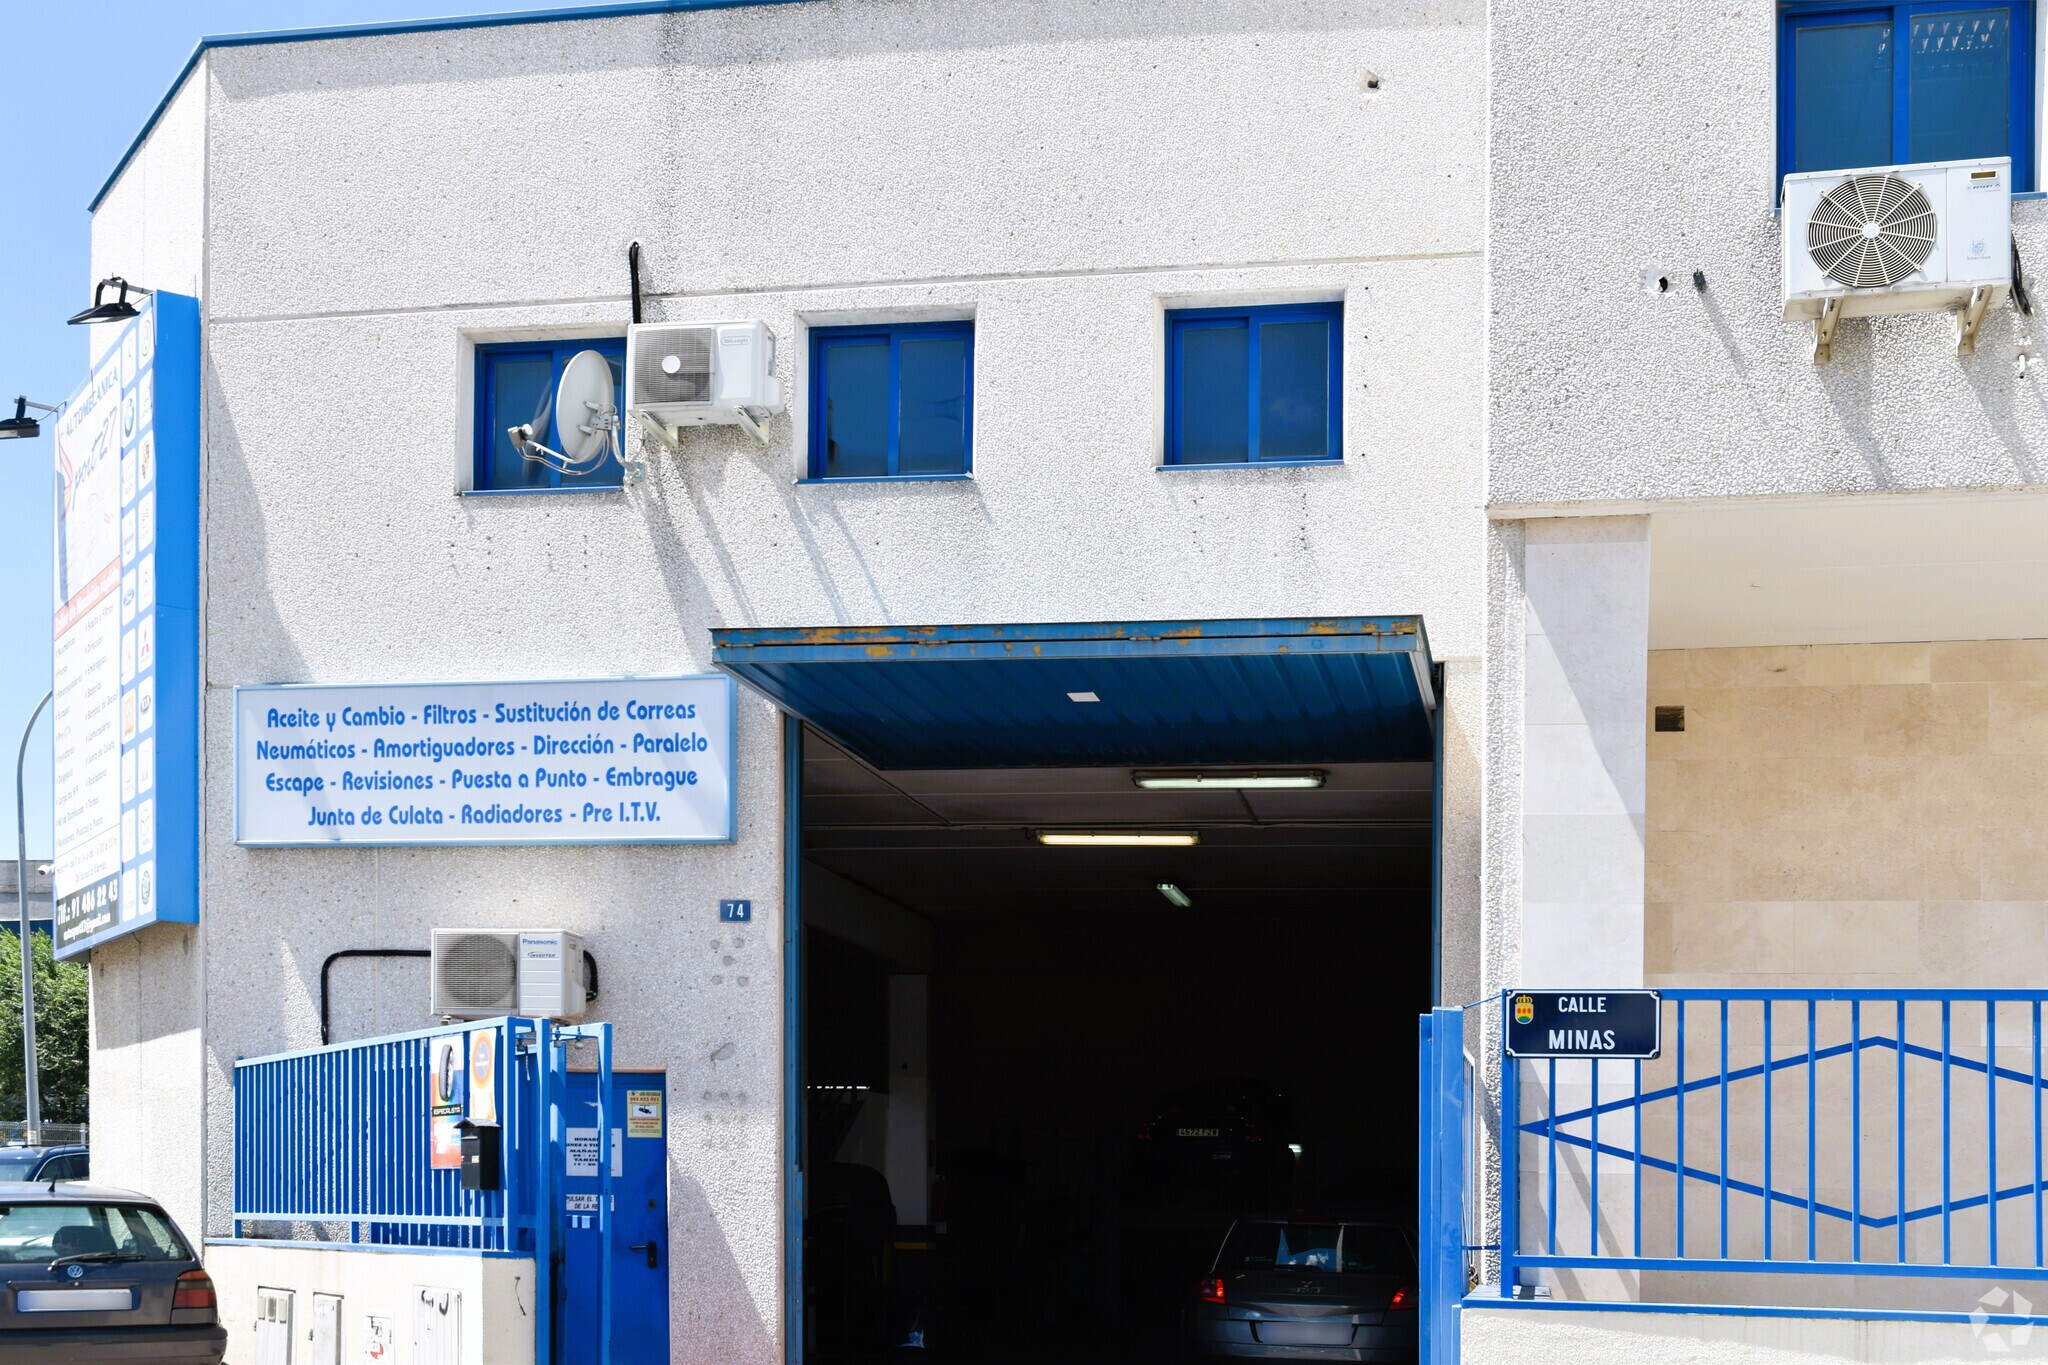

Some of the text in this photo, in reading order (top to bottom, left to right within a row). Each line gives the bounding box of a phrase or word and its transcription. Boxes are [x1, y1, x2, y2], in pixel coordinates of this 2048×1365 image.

[267, 708, 320, 729] Aceite
[326, 712, 336, 732] y
[342, 706, 406, 726] Cambio
[423, 704, 477, 725] Filtros
[495, 701, 591, 723] Sustitución
[597, 700, 620, 721] de
[626, 700, 696, 720] Correas
[256, 739, 356, 761] Neumáticos
[373, 736, 515, 763] Amortiguadores
[533, 734, 614, 755] Dirección
[633, 732, 708, 753] Paralelo
[266, 772, 324, 797] Escape
[342, 770, 433, 790] Revisiones
[452, 769, 512, 789] Puesta
[518, 773, 529, 788] a
[535, 767, 587, 788] Punto
[605, 767, 698, 792] Embrague
[308, 806, 355, 826] Junta
[361, 806, 382, 825] de
[389, 805, 443, 825] Culata
[461, 804, 562, 824] Radiadores
[583, 802, 612, 822] Pre
[620, 802, 660, 822] I.T.V.
[71, 896, 80, 919] 91
[97, 884, 107, 908] 22
[727, 903, 744, 918] 74
[1558, 996, 1607, 1013] CALLE
[1549, 1029, 1616, 1050] MINAS
